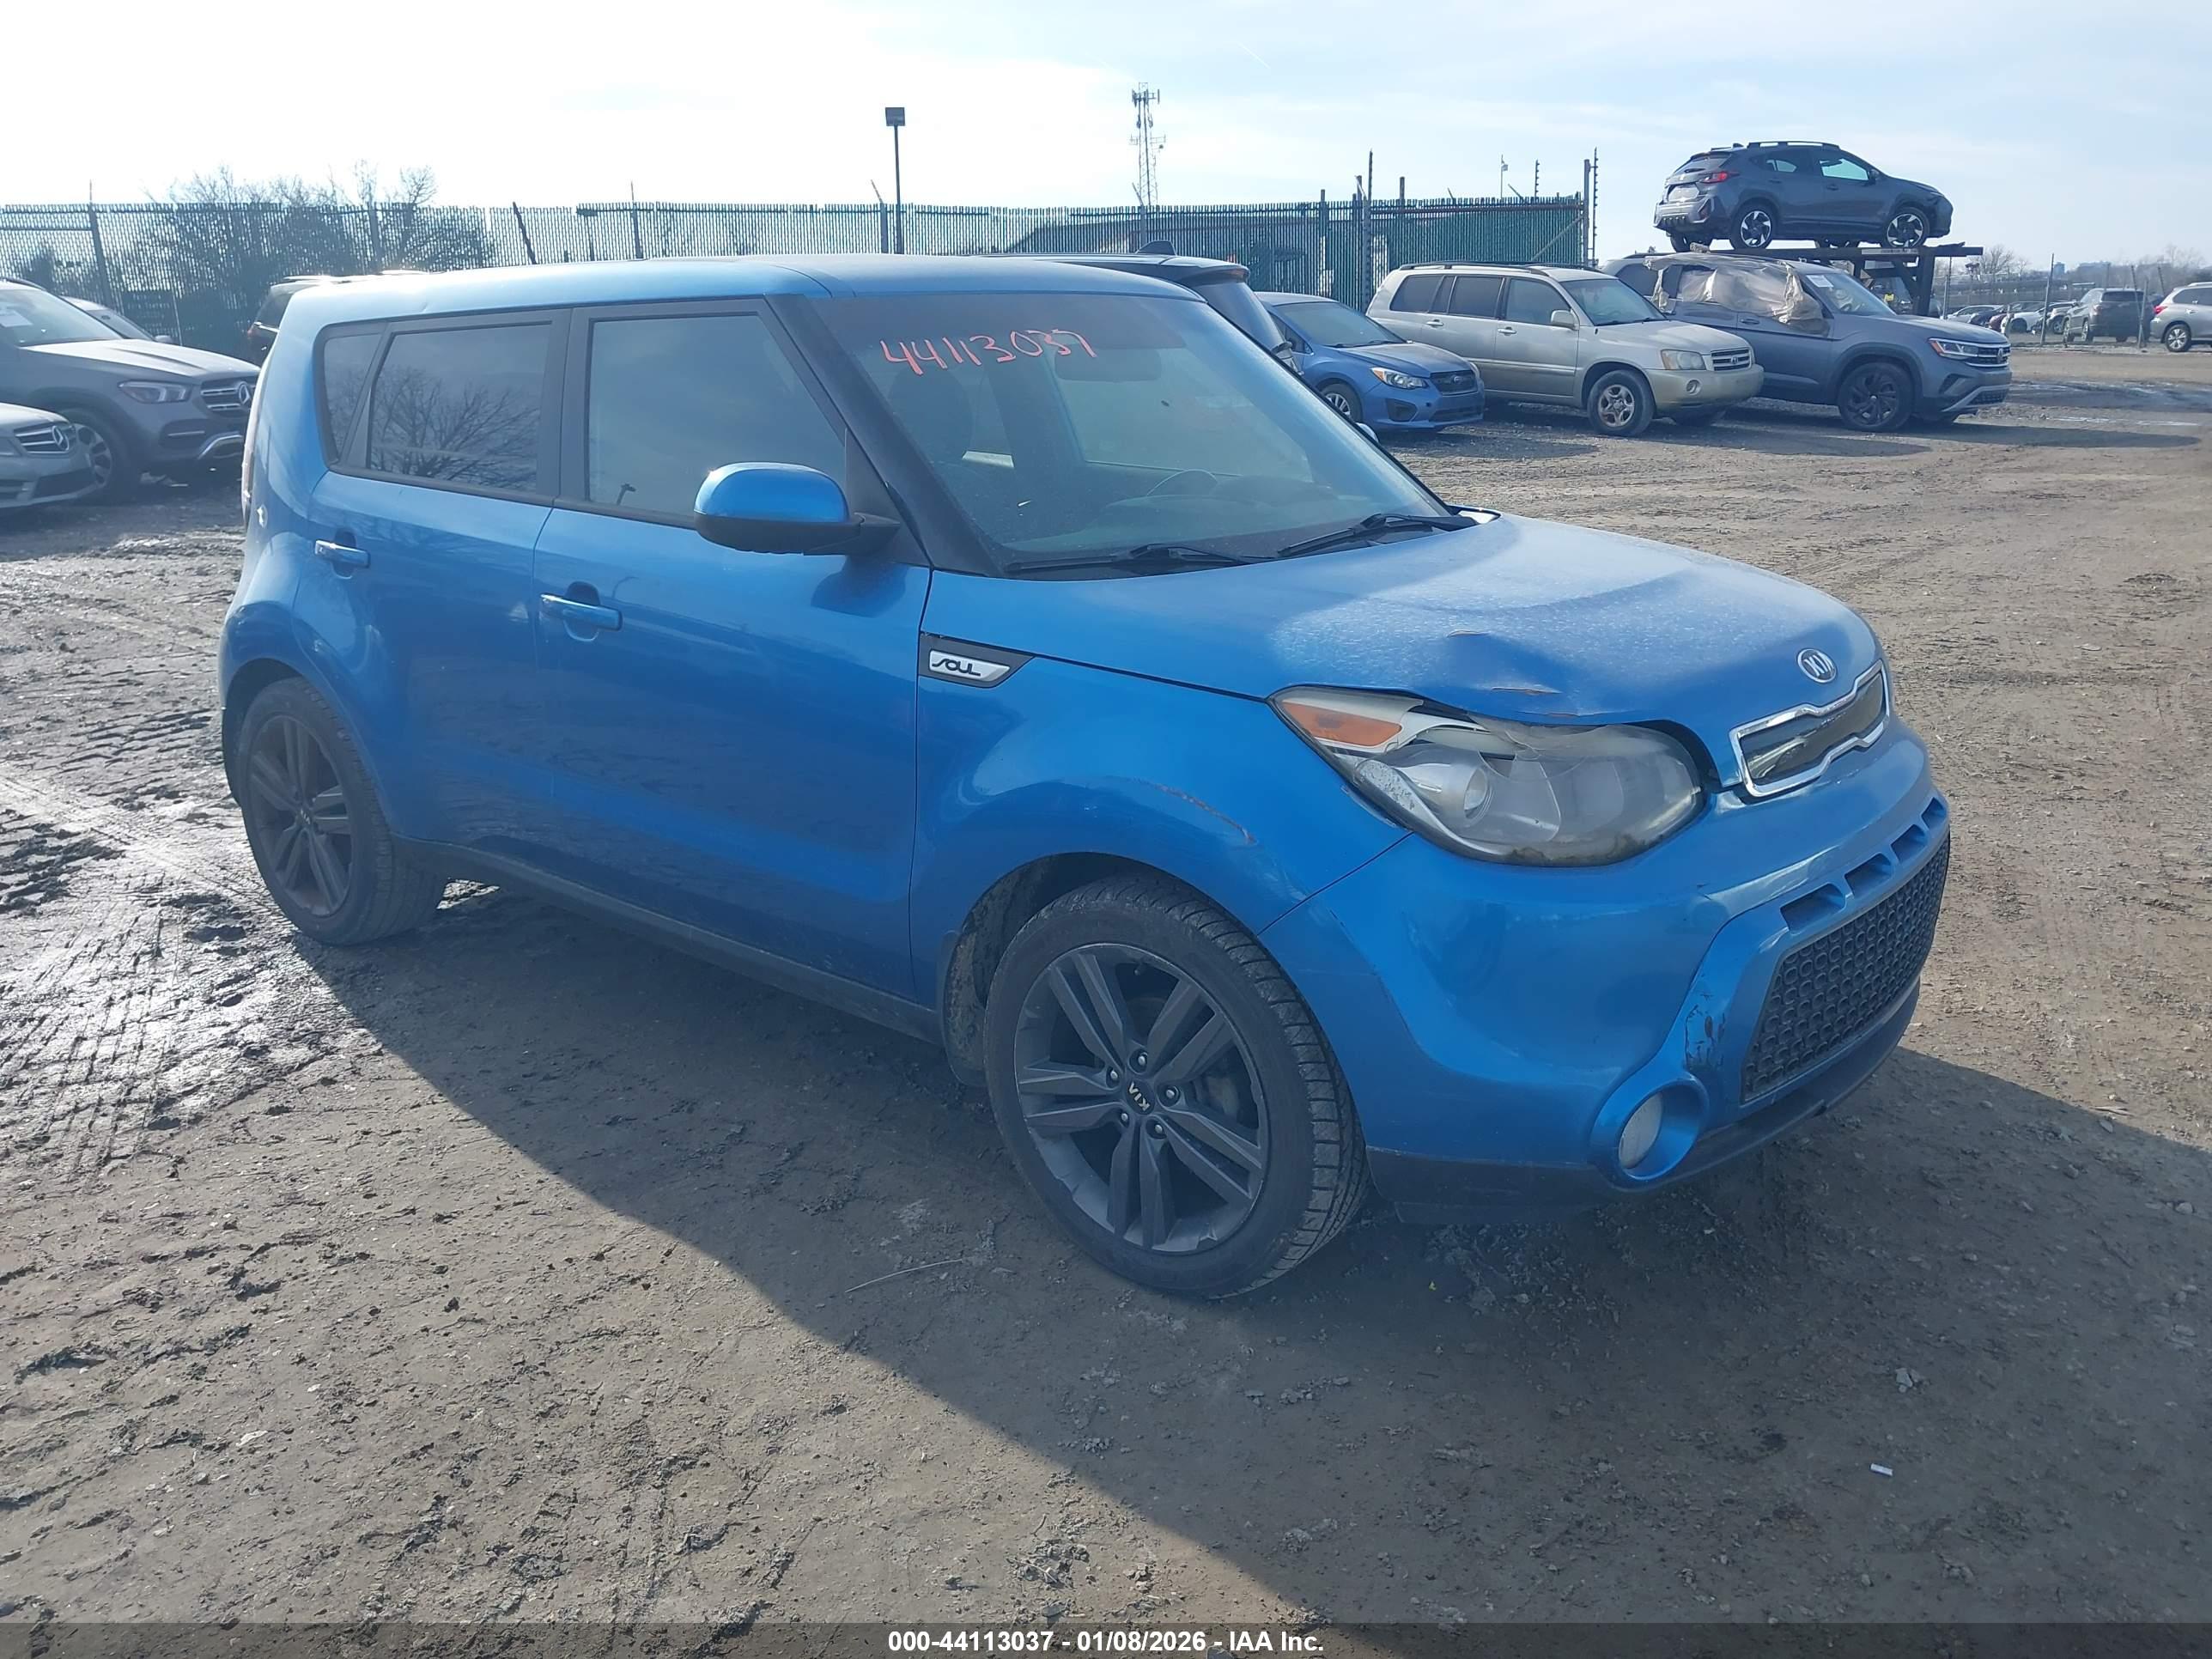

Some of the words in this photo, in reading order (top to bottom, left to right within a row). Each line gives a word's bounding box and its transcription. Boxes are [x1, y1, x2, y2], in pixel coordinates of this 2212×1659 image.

[879, 329, 1098, 375] 44113037
[932, 658, 981, 677] SOUL
[1128, 1081, 1151, 1112] KIA
